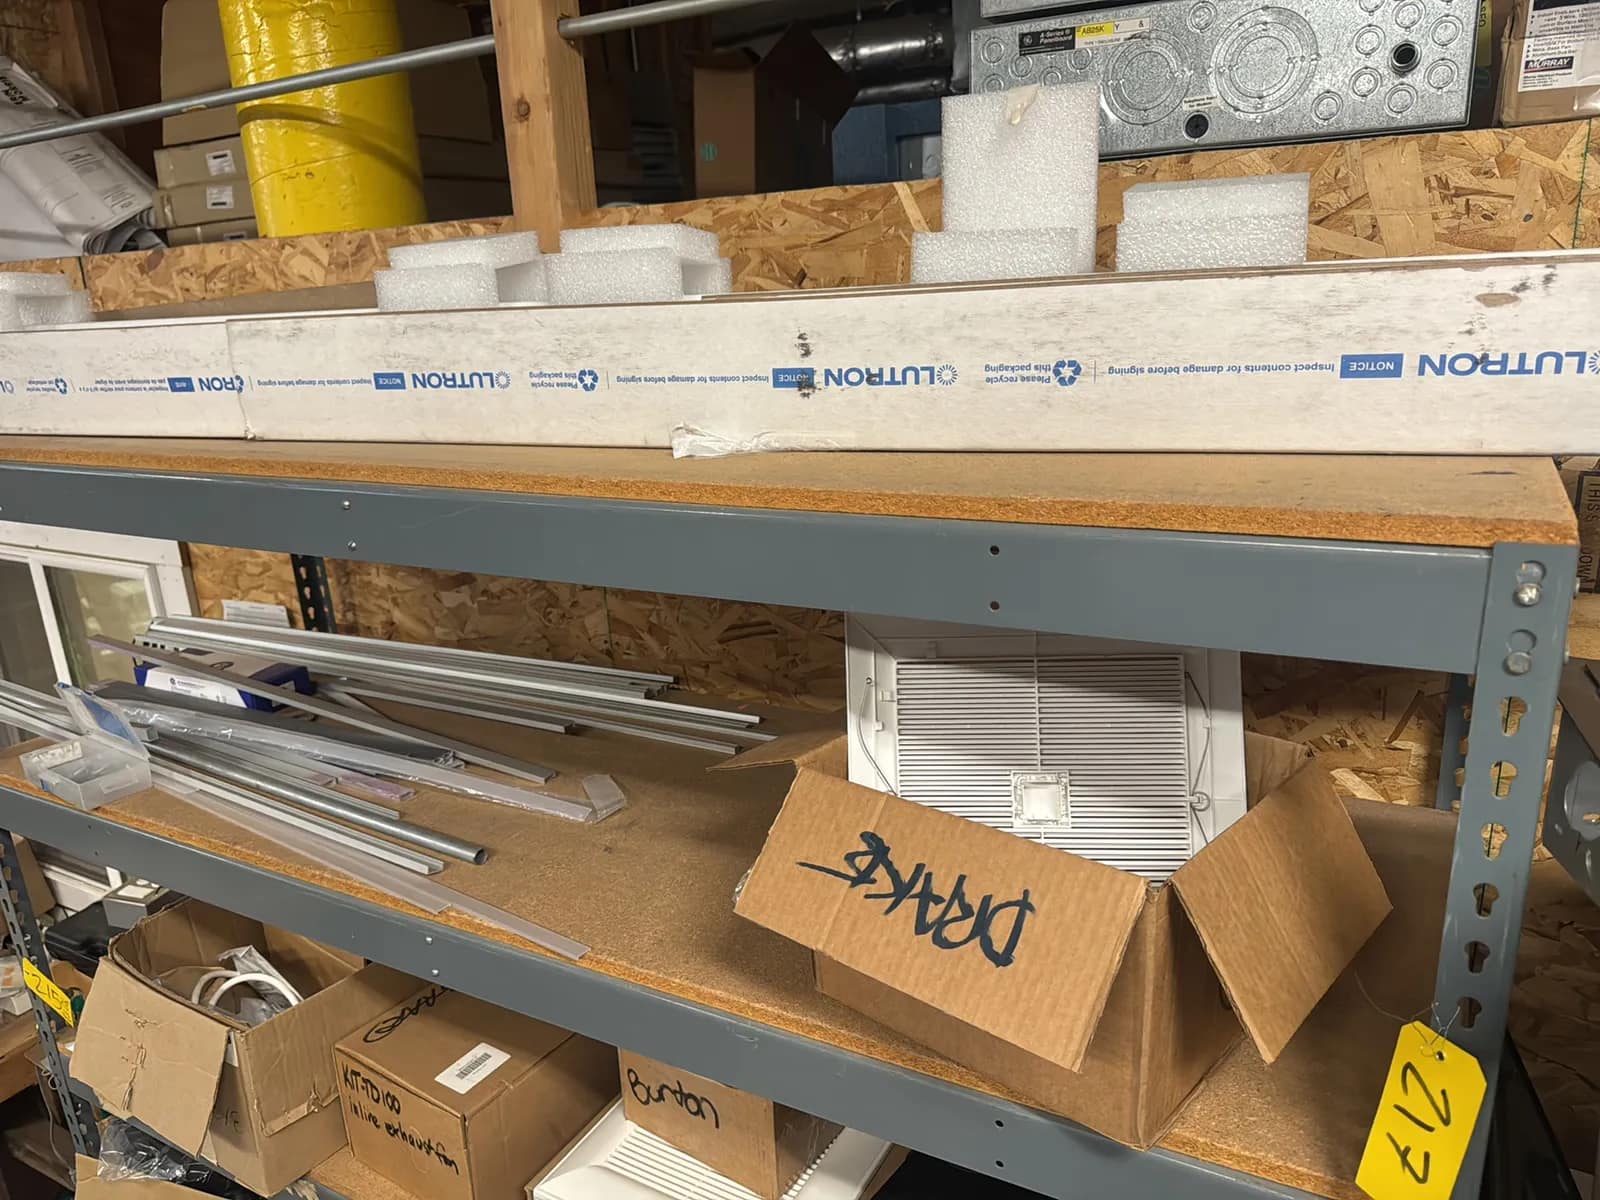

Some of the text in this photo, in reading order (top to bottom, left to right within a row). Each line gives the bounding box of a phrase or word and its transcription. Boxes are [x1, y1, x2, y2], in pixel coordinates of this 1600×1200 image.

[1527, 58, 1570, 69] MURRAY
[984, 363, 1051, 375] this packaging
[1108, 351, 1586, 377] LUTRON NOTICE Inspect contents for damage before signing
[412, 372, 494, 389] LUTRON
[529, 371, 577, 380] this packaging
[616, 375, 642, 384] signing
[644, 376, 666, 384] before
[668, 374, 695, 384] damage
[697, 376, 707, 384] for
[710, 375, 741, 383] contents
[743, 374, 769, 383] Inspect
[824, 366, 935, 387] LUTRON
[985, 375, 1051, 385] Please recycle
[199, 376, 234, 392] RON
[379, 377, 401, 386] NOTICE
[531, 381, 577, 390] Please recycle
[796, 831, 1036, 968] DRAKE
[1386, 1061, 1451, 1184] 217
